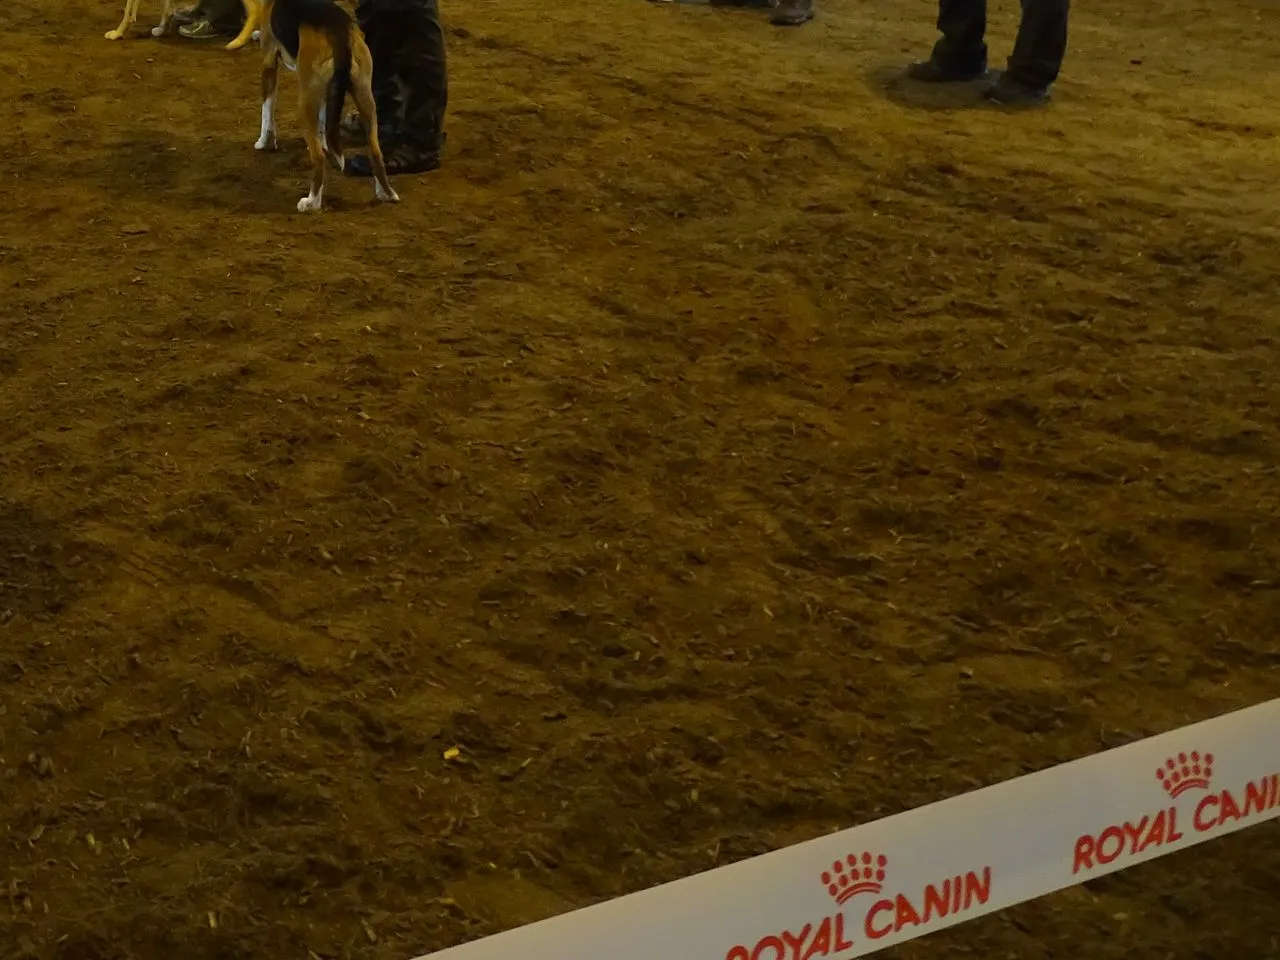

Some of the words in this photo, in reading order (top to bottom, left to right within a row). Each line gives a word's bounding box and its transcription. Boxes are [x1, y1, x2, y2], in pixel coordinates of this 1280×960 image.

[1073, 806, 1183, 874] ROYAL
[1193, 773, 1280, 832] CANI
[864, 866, 991, 939] CANIN
